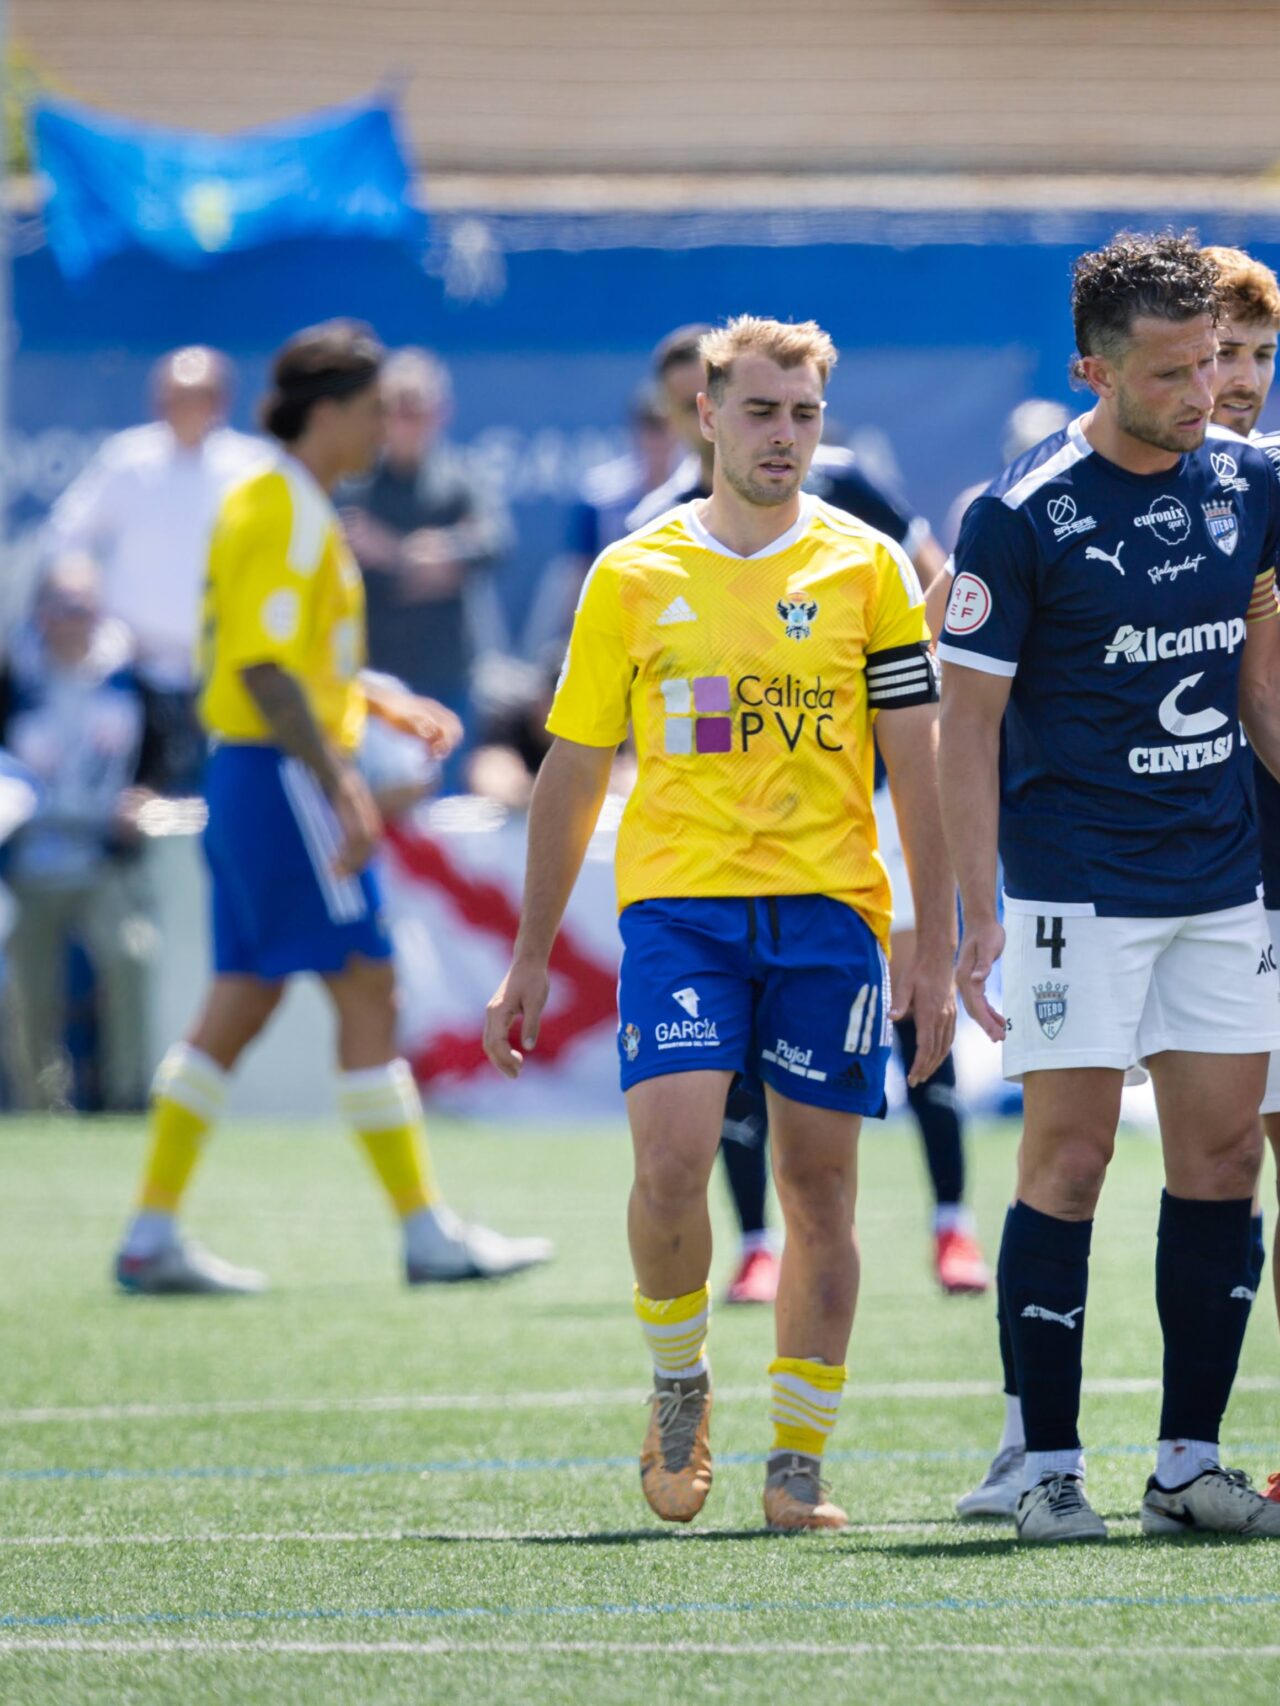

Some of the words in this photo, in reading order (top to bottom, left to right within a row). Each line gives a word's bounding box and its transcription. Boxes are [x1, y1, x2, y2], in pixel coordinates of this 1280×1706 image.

[1133, 505, 1185, 528] euronix
[1209, 517, 1235, 539] UTEBO
[1103, 617, 1247, 664] Alcamp
[736, 674, 835, 710] Cálida
[741, 711, 843, 753] PVC
[1036, 915, 1066, 969] 4
[843, 983, 878, 1056] 11
[1037, 1002, 1064, 1020] UTEBO
[655, 1017, 719, 1042] GARCÍA
[776, 1038, 814, 1067] Pujol
